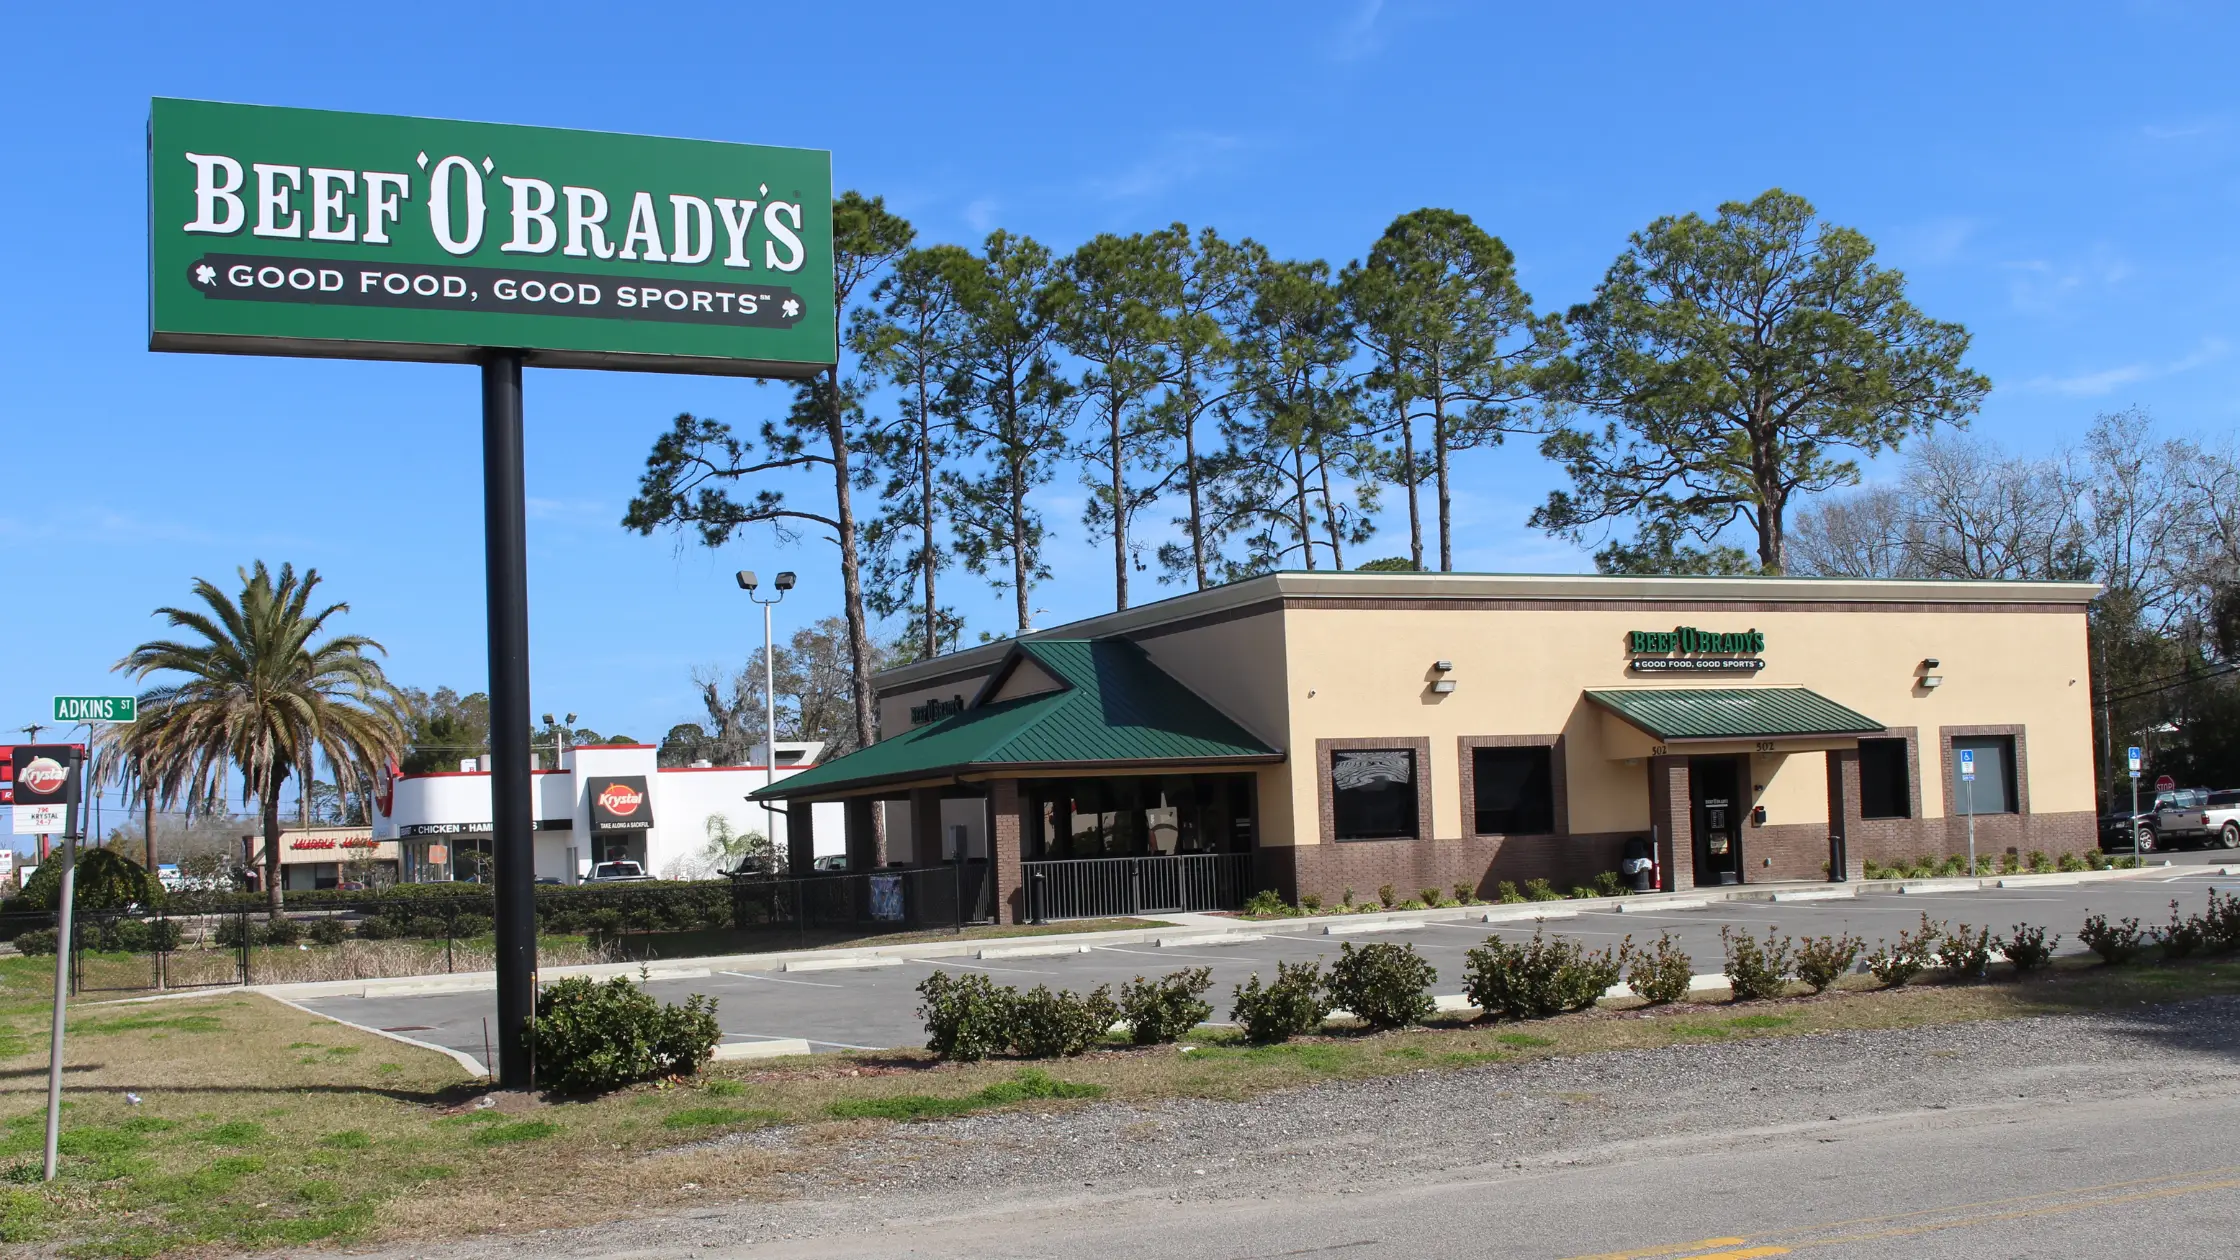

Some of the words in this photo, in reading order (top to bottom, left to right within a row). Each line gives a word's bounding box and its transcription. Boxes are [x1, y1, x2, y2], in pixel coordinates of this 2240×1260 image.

[183, 151, 411, 246] BEEF
[500, 175, 806, 273] BRADY'S
[228, 264, 344, 292] GOOD
[360, 271, 478, 302] FOOD,
[493, 279, 601, 306] GOOD
[617, 286, 758, 315] SPORTS
[1633, 631, 1679, 652] BEEF
[1697, 628, 1765, 653] BRADY'S
[1668, 661, 1695, 669] FOOD,
[58, 699, 114, 718] ADKINS
[121, 700, 131, 710] ST
[1652, 745, 1667, 755] 502
[1756, 741, 1775, 752] 502
[18, 766, 70, 785] Krystal
[2156, 783, 2173, 791] STOP
[598, 792, 643, 808] Krystal
[418, 824, 460, 834] CHICKEN
